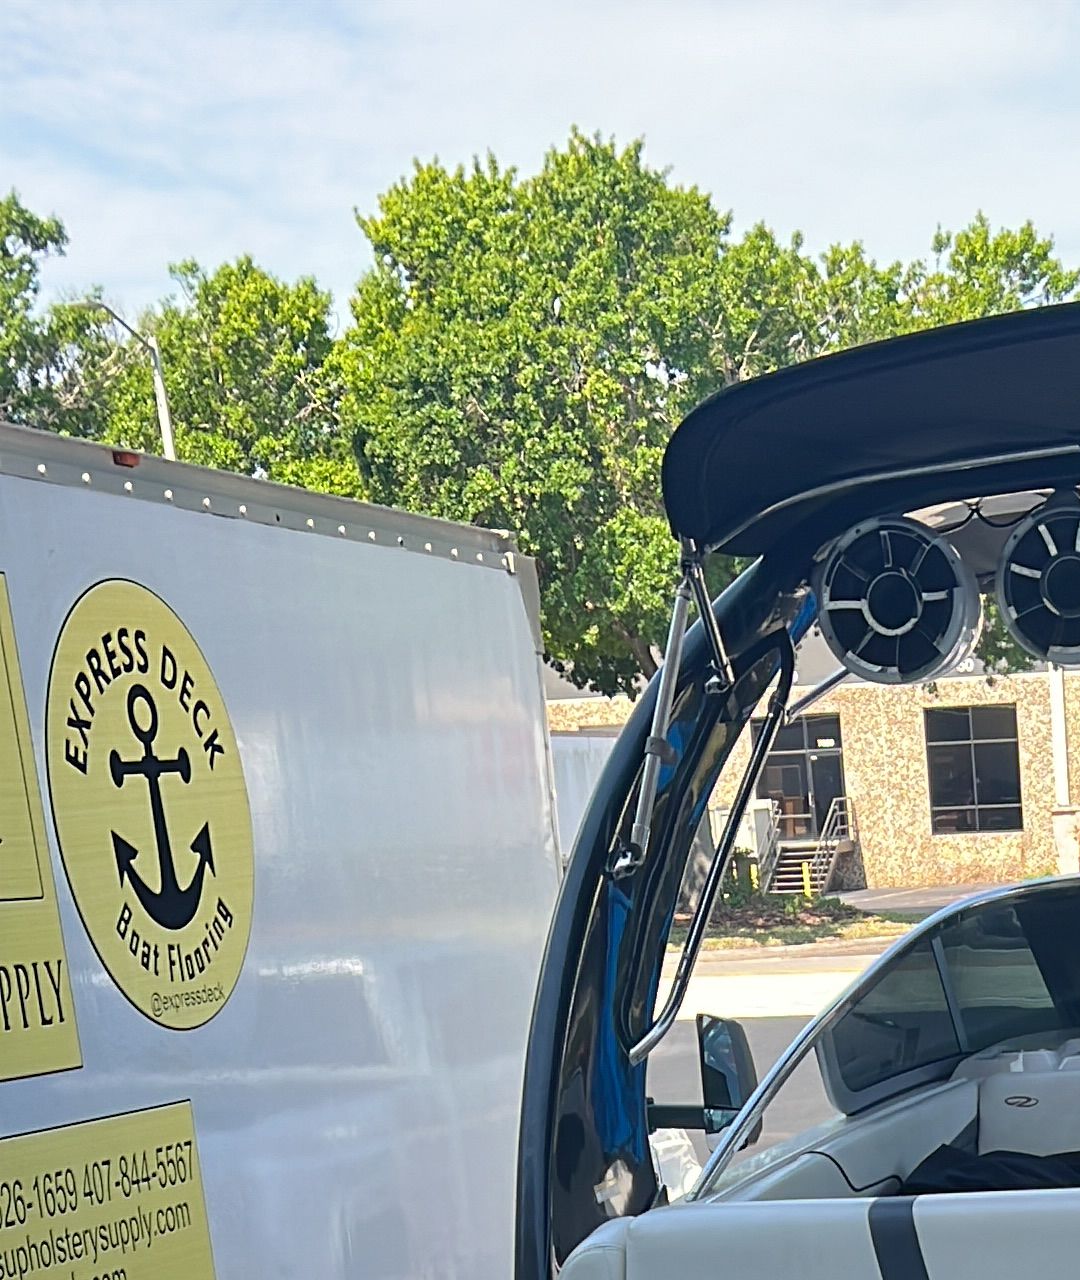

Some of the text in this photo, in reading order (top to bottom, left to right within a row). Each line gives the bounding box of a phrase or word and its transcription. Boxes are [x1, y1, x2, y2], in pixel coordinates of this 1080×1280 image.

[66, 628, 225, 775] EXPRESS DECK
[116, 897, 233, 982] Boat Flooring
[0, 960, 65, 1031] PPLY
[151, 983, 226, 1017] @expressdeck
[0, 1140, 193, 1229] 26-1659 407-844-5567
